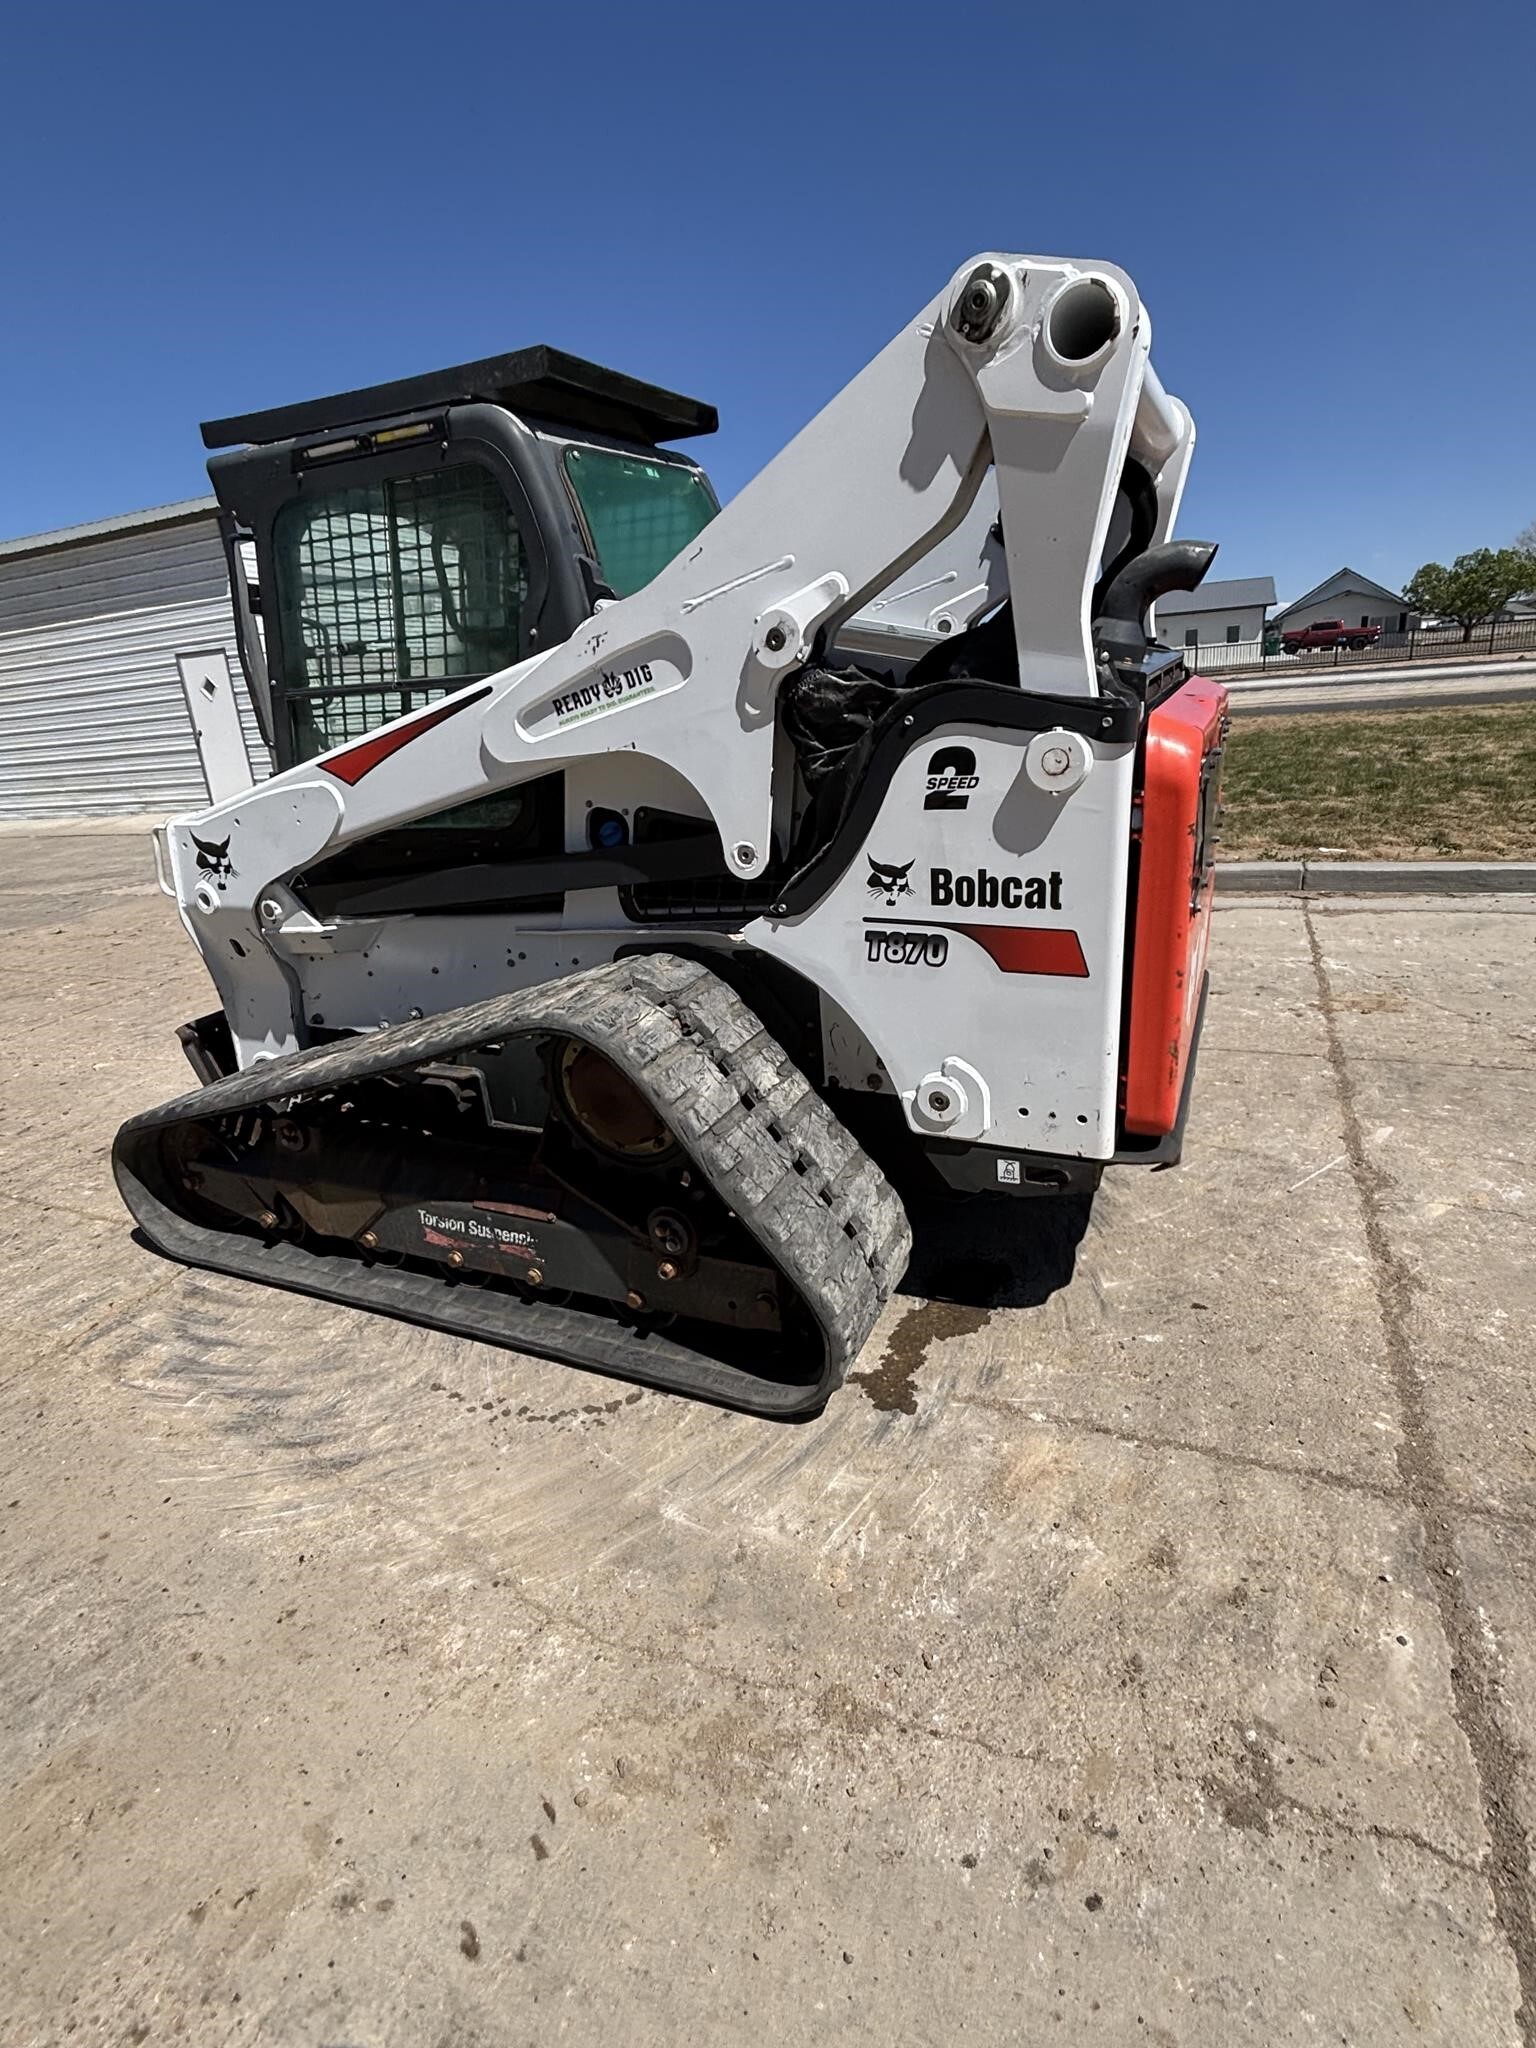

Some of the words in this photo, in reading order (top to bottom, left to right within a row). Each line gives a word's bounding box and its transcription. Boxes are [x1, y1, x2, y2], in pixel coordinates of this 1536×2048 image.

[552, 683, 600, 716] READY
[624, 664, 653, 689] DIG
[924, 746, 976, 810] 2
[926, 776, 980, 790] SPEED
[930, 868, 1062, 910] Bobcat
[865, 930, 948, 967] T870
[418, 1209, 465, 1232] Torsion
